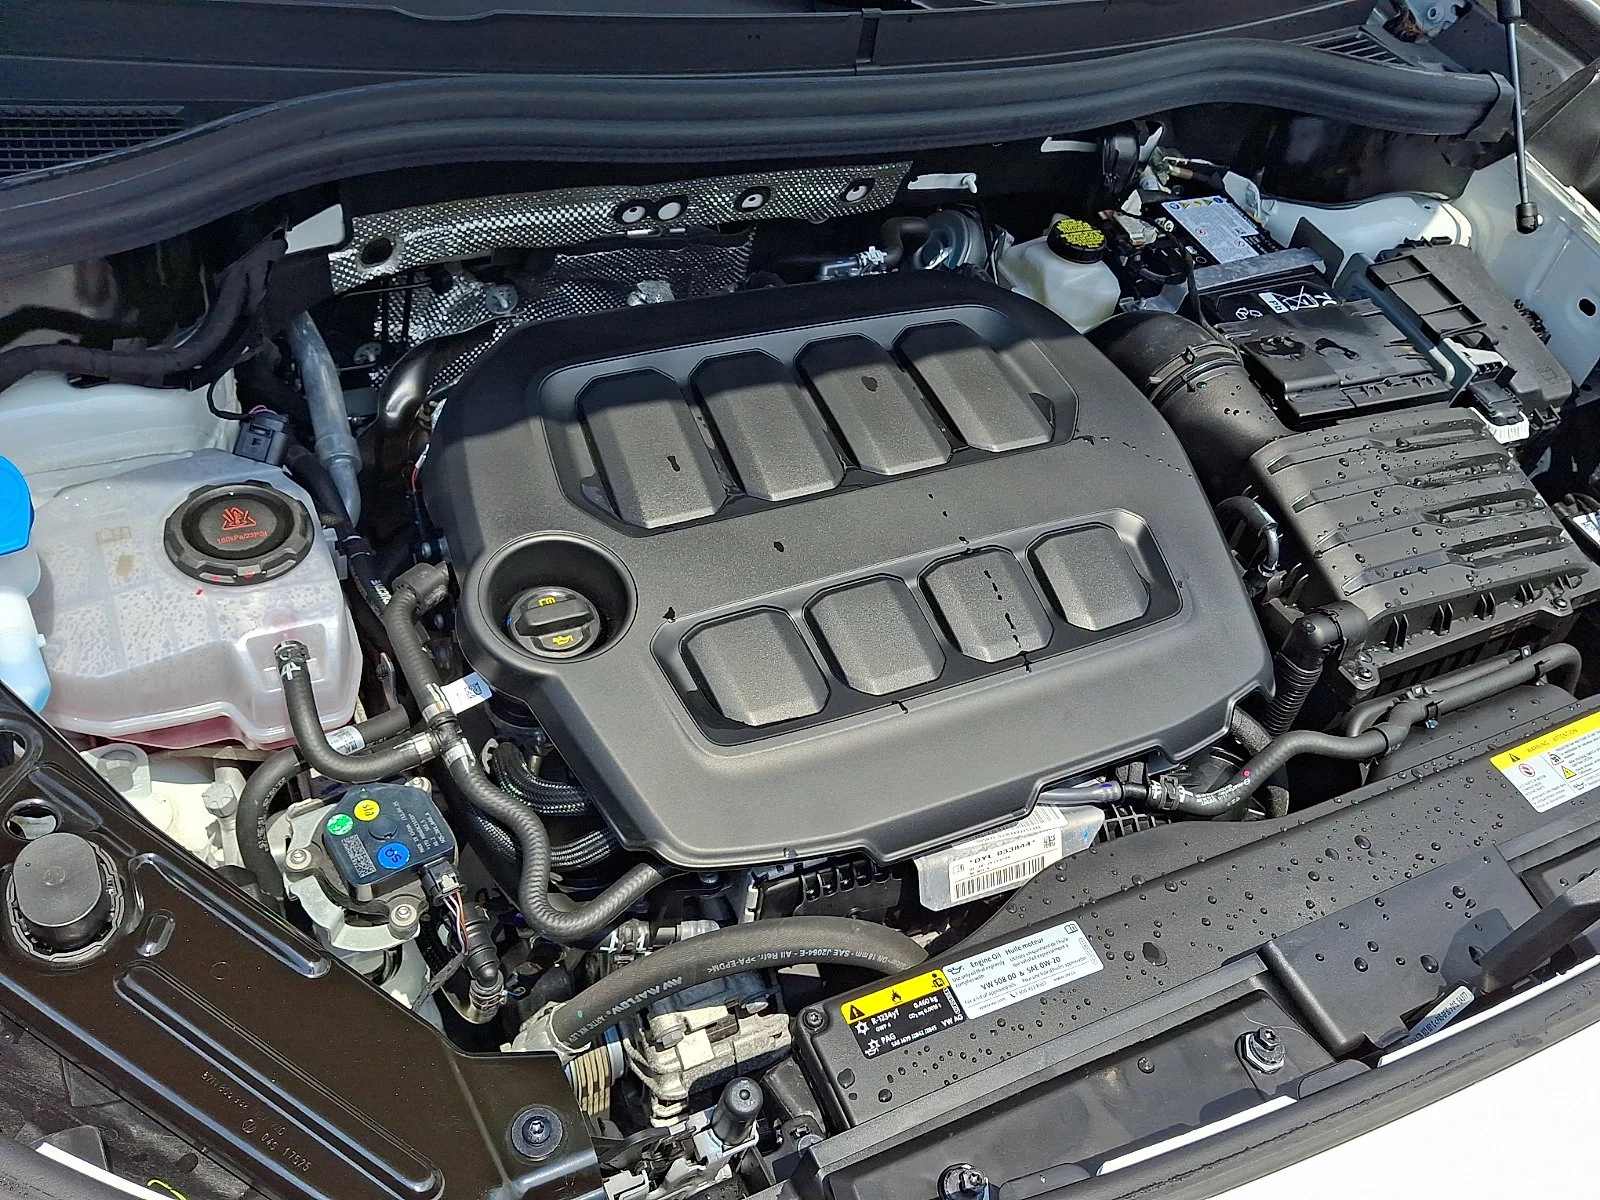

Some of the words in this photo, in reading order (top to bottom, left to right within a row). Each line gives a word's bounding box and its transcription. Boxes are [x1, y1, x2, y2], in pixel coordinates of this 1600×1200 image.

[833, 948, 850, 957] SAE
[1004, 945, 1022, 955] Huile
[1021, 937, 1043, 948] moteur
[969, 956, 991, 967] Engine
[980, 980, 993, 989] VW
[993, 976, 1007, 985] 508
[1006, 972, 1016, 980] 00
[1026, 964, 1038, 973] SAE
[870, 1007, 899, 1025] R-1234yf
[940, 1017, 953, 1026] VW
[953, 1013, 963, 1022] AG
[880, 1032, 896, 1044] PAG
